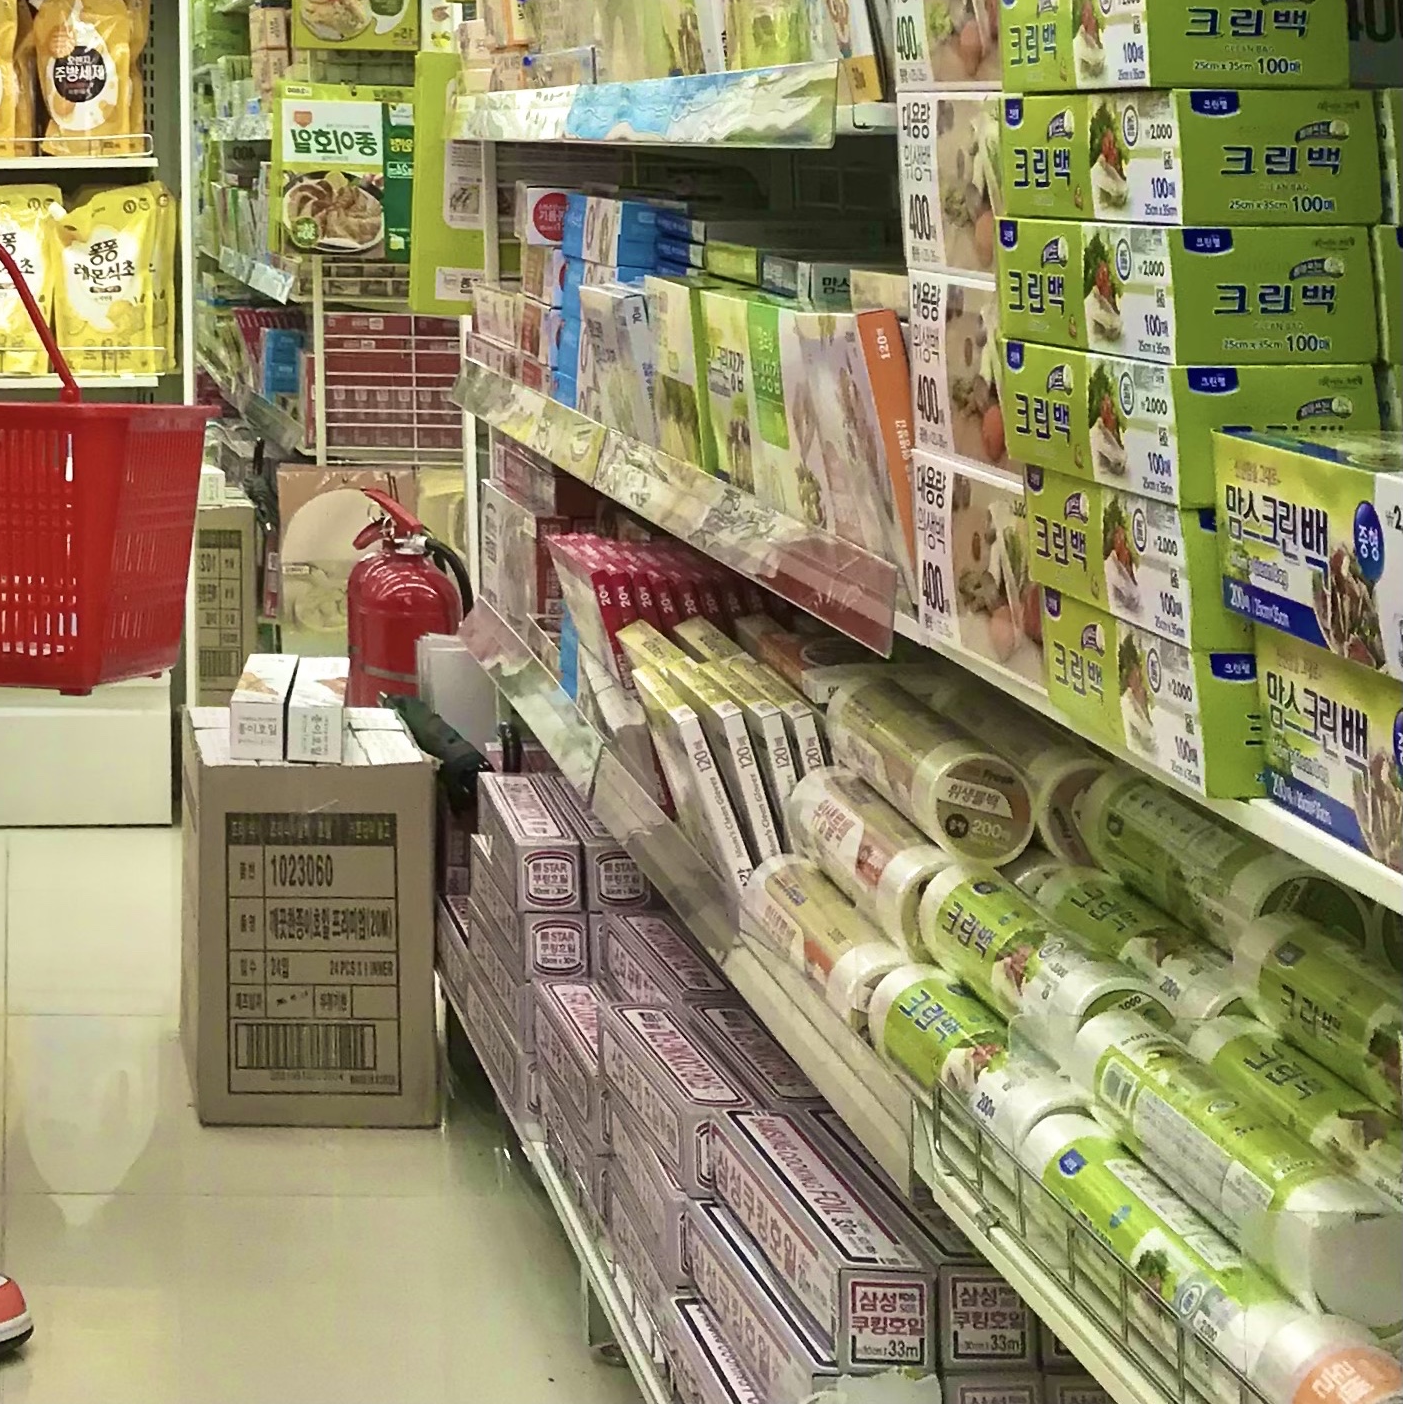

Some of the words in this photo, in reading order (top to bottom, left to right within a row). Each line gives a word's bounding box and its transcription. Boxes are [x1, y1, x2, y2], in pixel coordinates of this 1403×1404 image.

[1185, 7, 1310, 38] 크린백
[1010, 24, 1057, 66] 크린백
[54, 64, 107, 84] 주방세제
[1257, 57, 1302, 75] 100매
[903, 103, 931, 140] 대용량
[1013, 146, 1071, 189] 크린백
[1220, 145, 1343, 176] 크린백
[1291, 195, 1336, 214] 100매
[89, 238, 119, 267] 퐁퐁
[74, 259, 137, 288] 레몬식초
[1008, 270, 1066, 314] 크린백
[1213, 283, 1337, 316] 크린백
[1285, 334, 1331, 353] 100매
[1015, 393, 1071, 445] 크린백
[1146, 451, 1172, 477] 100매
[916, 466, 946, 505] 대용량
[1034, 516, 1087, 571] 크린백
[1226, 484, 1329, 586] 맘스크린백
[1358, 522, 1381, 563] 중형
[1159, 590, 1184, 620] 100매
[1054, 643, 1104, 698] 크린백
[1267, 671, 1369, 782] 맘스크린백
[271, 854, 334, 888] 1023060
[543, 862, 567, 874] STAR
[551, 931, 575, 942] STAR
[942, 900, 998, 964] 크린백
[898, 988, 962, 1044] 크린백
[859, 1291, 899, 1313] 삼성
[960, 1287, 998, 1306] 삼성
[851, 1317, 925, 1337] 쿠킹호일
[953, 1311, 1027, 1331] 쿠킹호일
[888, 1340, 920, 1358] 33m
